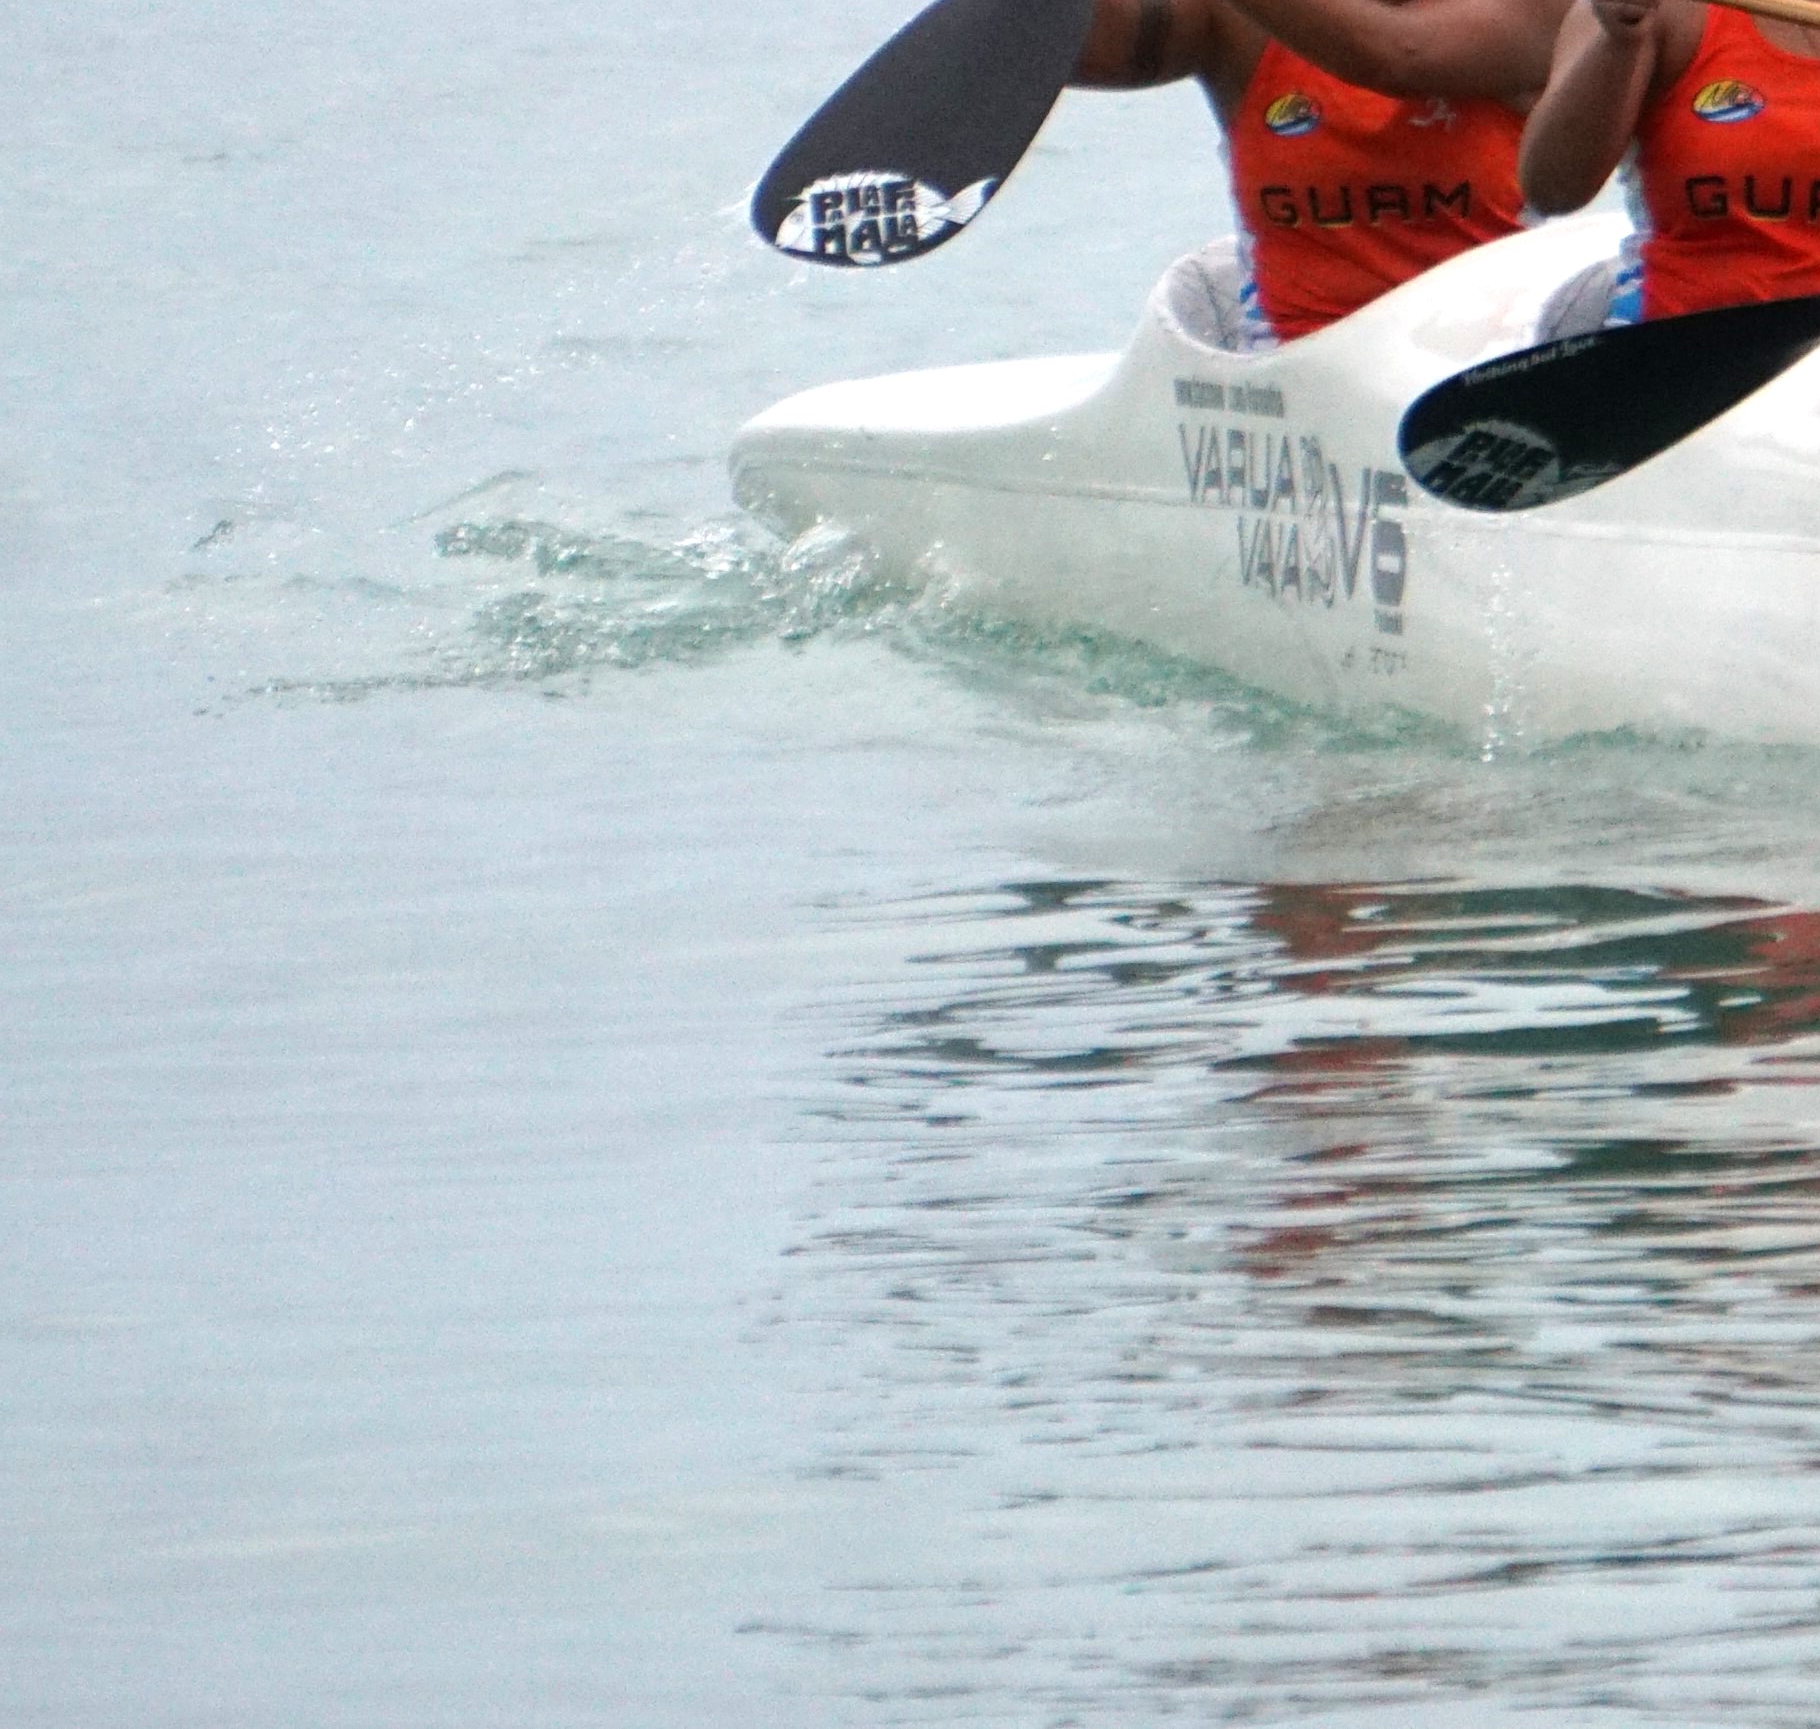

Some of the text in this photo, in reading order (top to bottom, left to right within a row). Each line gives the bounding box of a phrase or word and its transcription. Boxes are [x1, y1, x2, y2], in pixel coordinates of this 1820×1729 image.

[1260, 180, 1472, 225] GUAM
[1179, 423, 1297, 509] VARUA
[1328, 462, 1407, 606] V6
